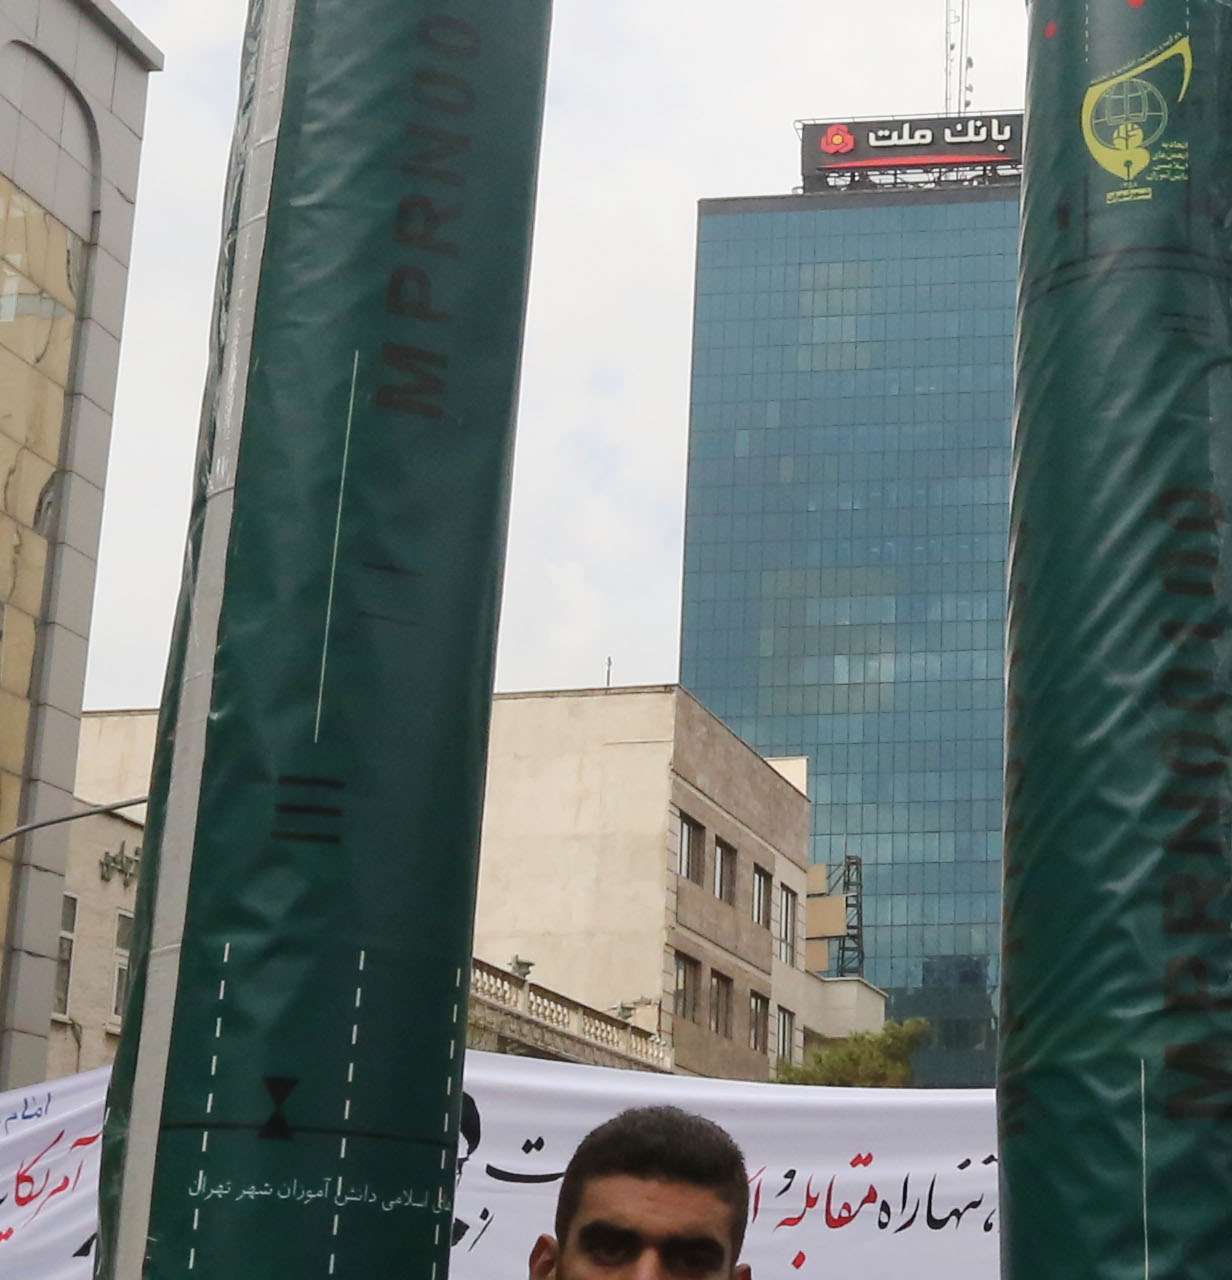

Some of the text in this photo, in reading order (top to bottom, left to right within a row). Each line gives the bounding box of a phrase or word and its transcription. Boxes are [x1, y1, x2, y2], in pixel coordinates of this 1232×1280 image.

[868, 122, 933, 147] ملت
[6, 1091, 52, 1136] امام
[188, 1175, 232, 1201] تهران
[235, 1181, 274, 1201] شهر
[277, 1177, 333, 1205] آموزان
[334, 1183, 378, 1206] دانش
[775, 1169, 797, 1198] و
[926, 1154, 998, 1231] تنها
[382, 1186, 429, 1212] اسلامی
[773, 1152, 878, 1270] مقابله
[878, 1172, 920, 1234] راه
